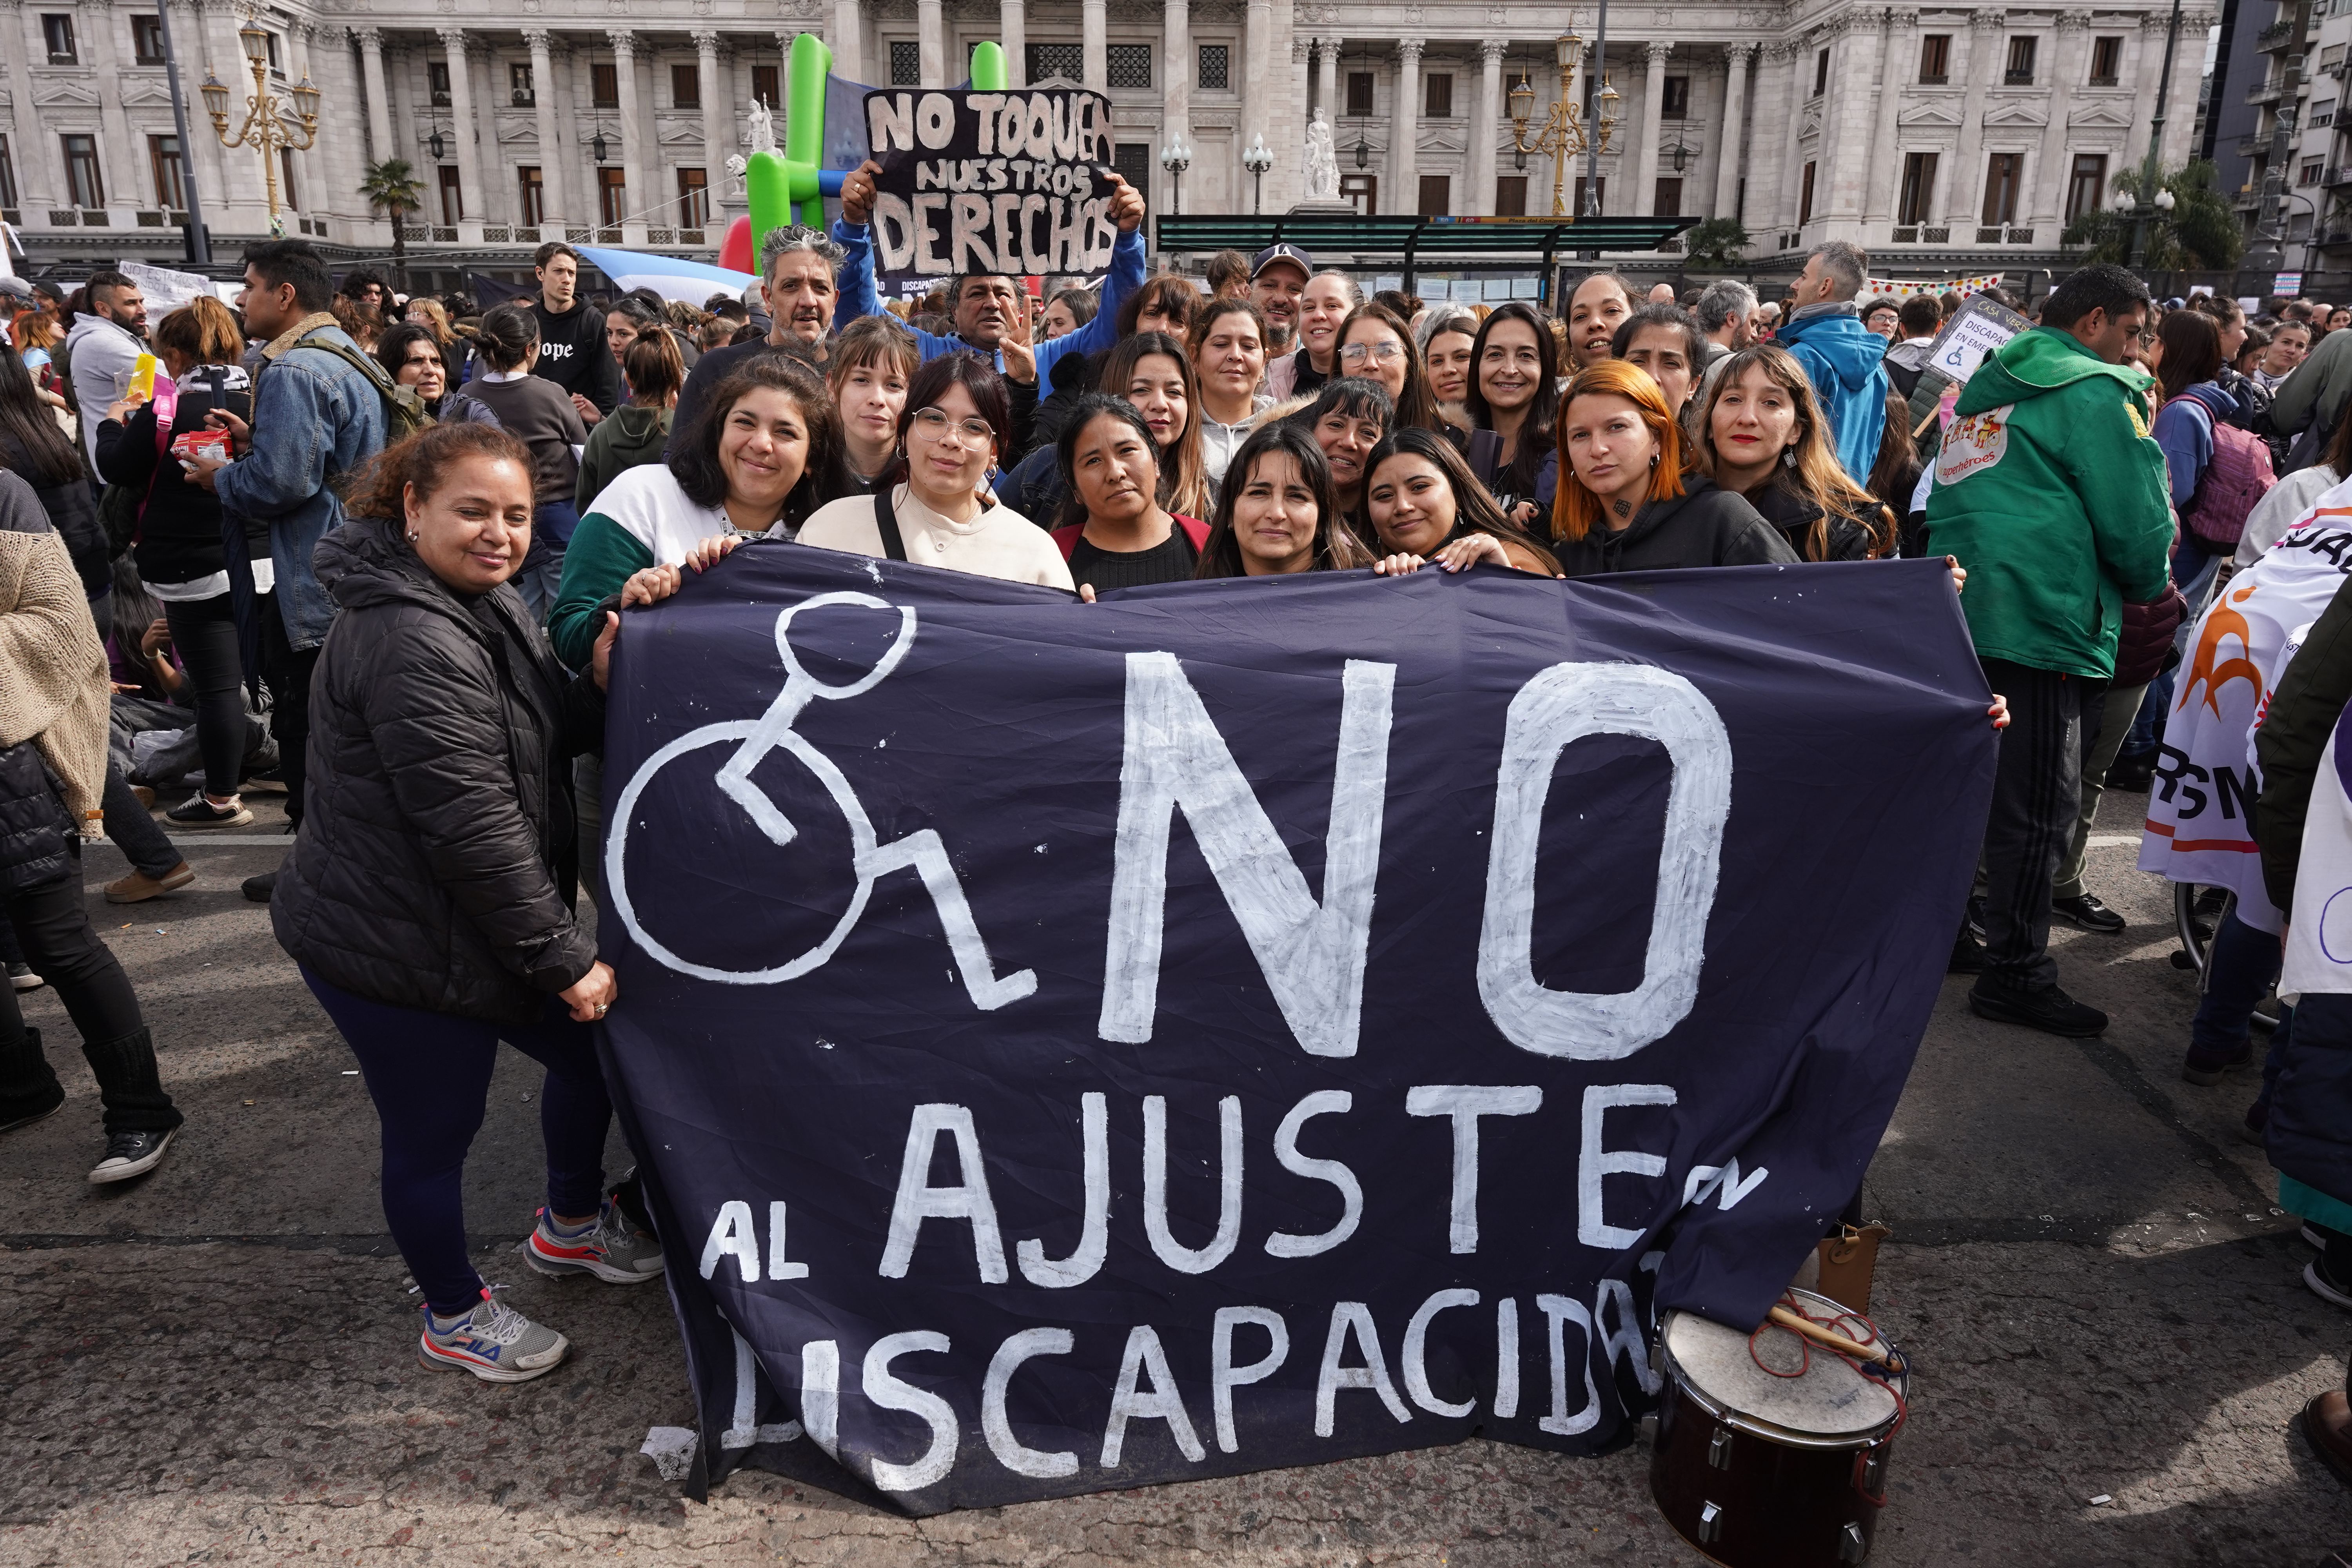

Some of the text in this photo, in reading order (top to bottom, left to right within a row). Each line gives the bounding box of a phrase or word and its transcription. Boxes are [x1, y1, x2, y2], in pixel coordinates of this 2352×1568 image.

[868, 92, 1115, 167] NO TOQUEN
[916, 158, 1093, 201] NUESTROS
[873, 191, 1118, 275] DERECHOS
[1272, 243, 1292, 257] LA
[123, 264, 195, 285] NO ESTAMOS
[163, 284, 173, 293] DE
[1978, 301, 2000, 318] CASA
[1955, 332, 1968, 343] EN
[540, 342, 573, 361] ope
[1943, 451, 1995, 478] superhéroes
[1098, 651, 1733, 1061] NO
[699, 1200, 809, 1282] AL
[878, 1084, 1677, 1289] AJUSTE
[490, 1305, 499, 1318] FILA
[450, 1336, 501, 1361] FILA
